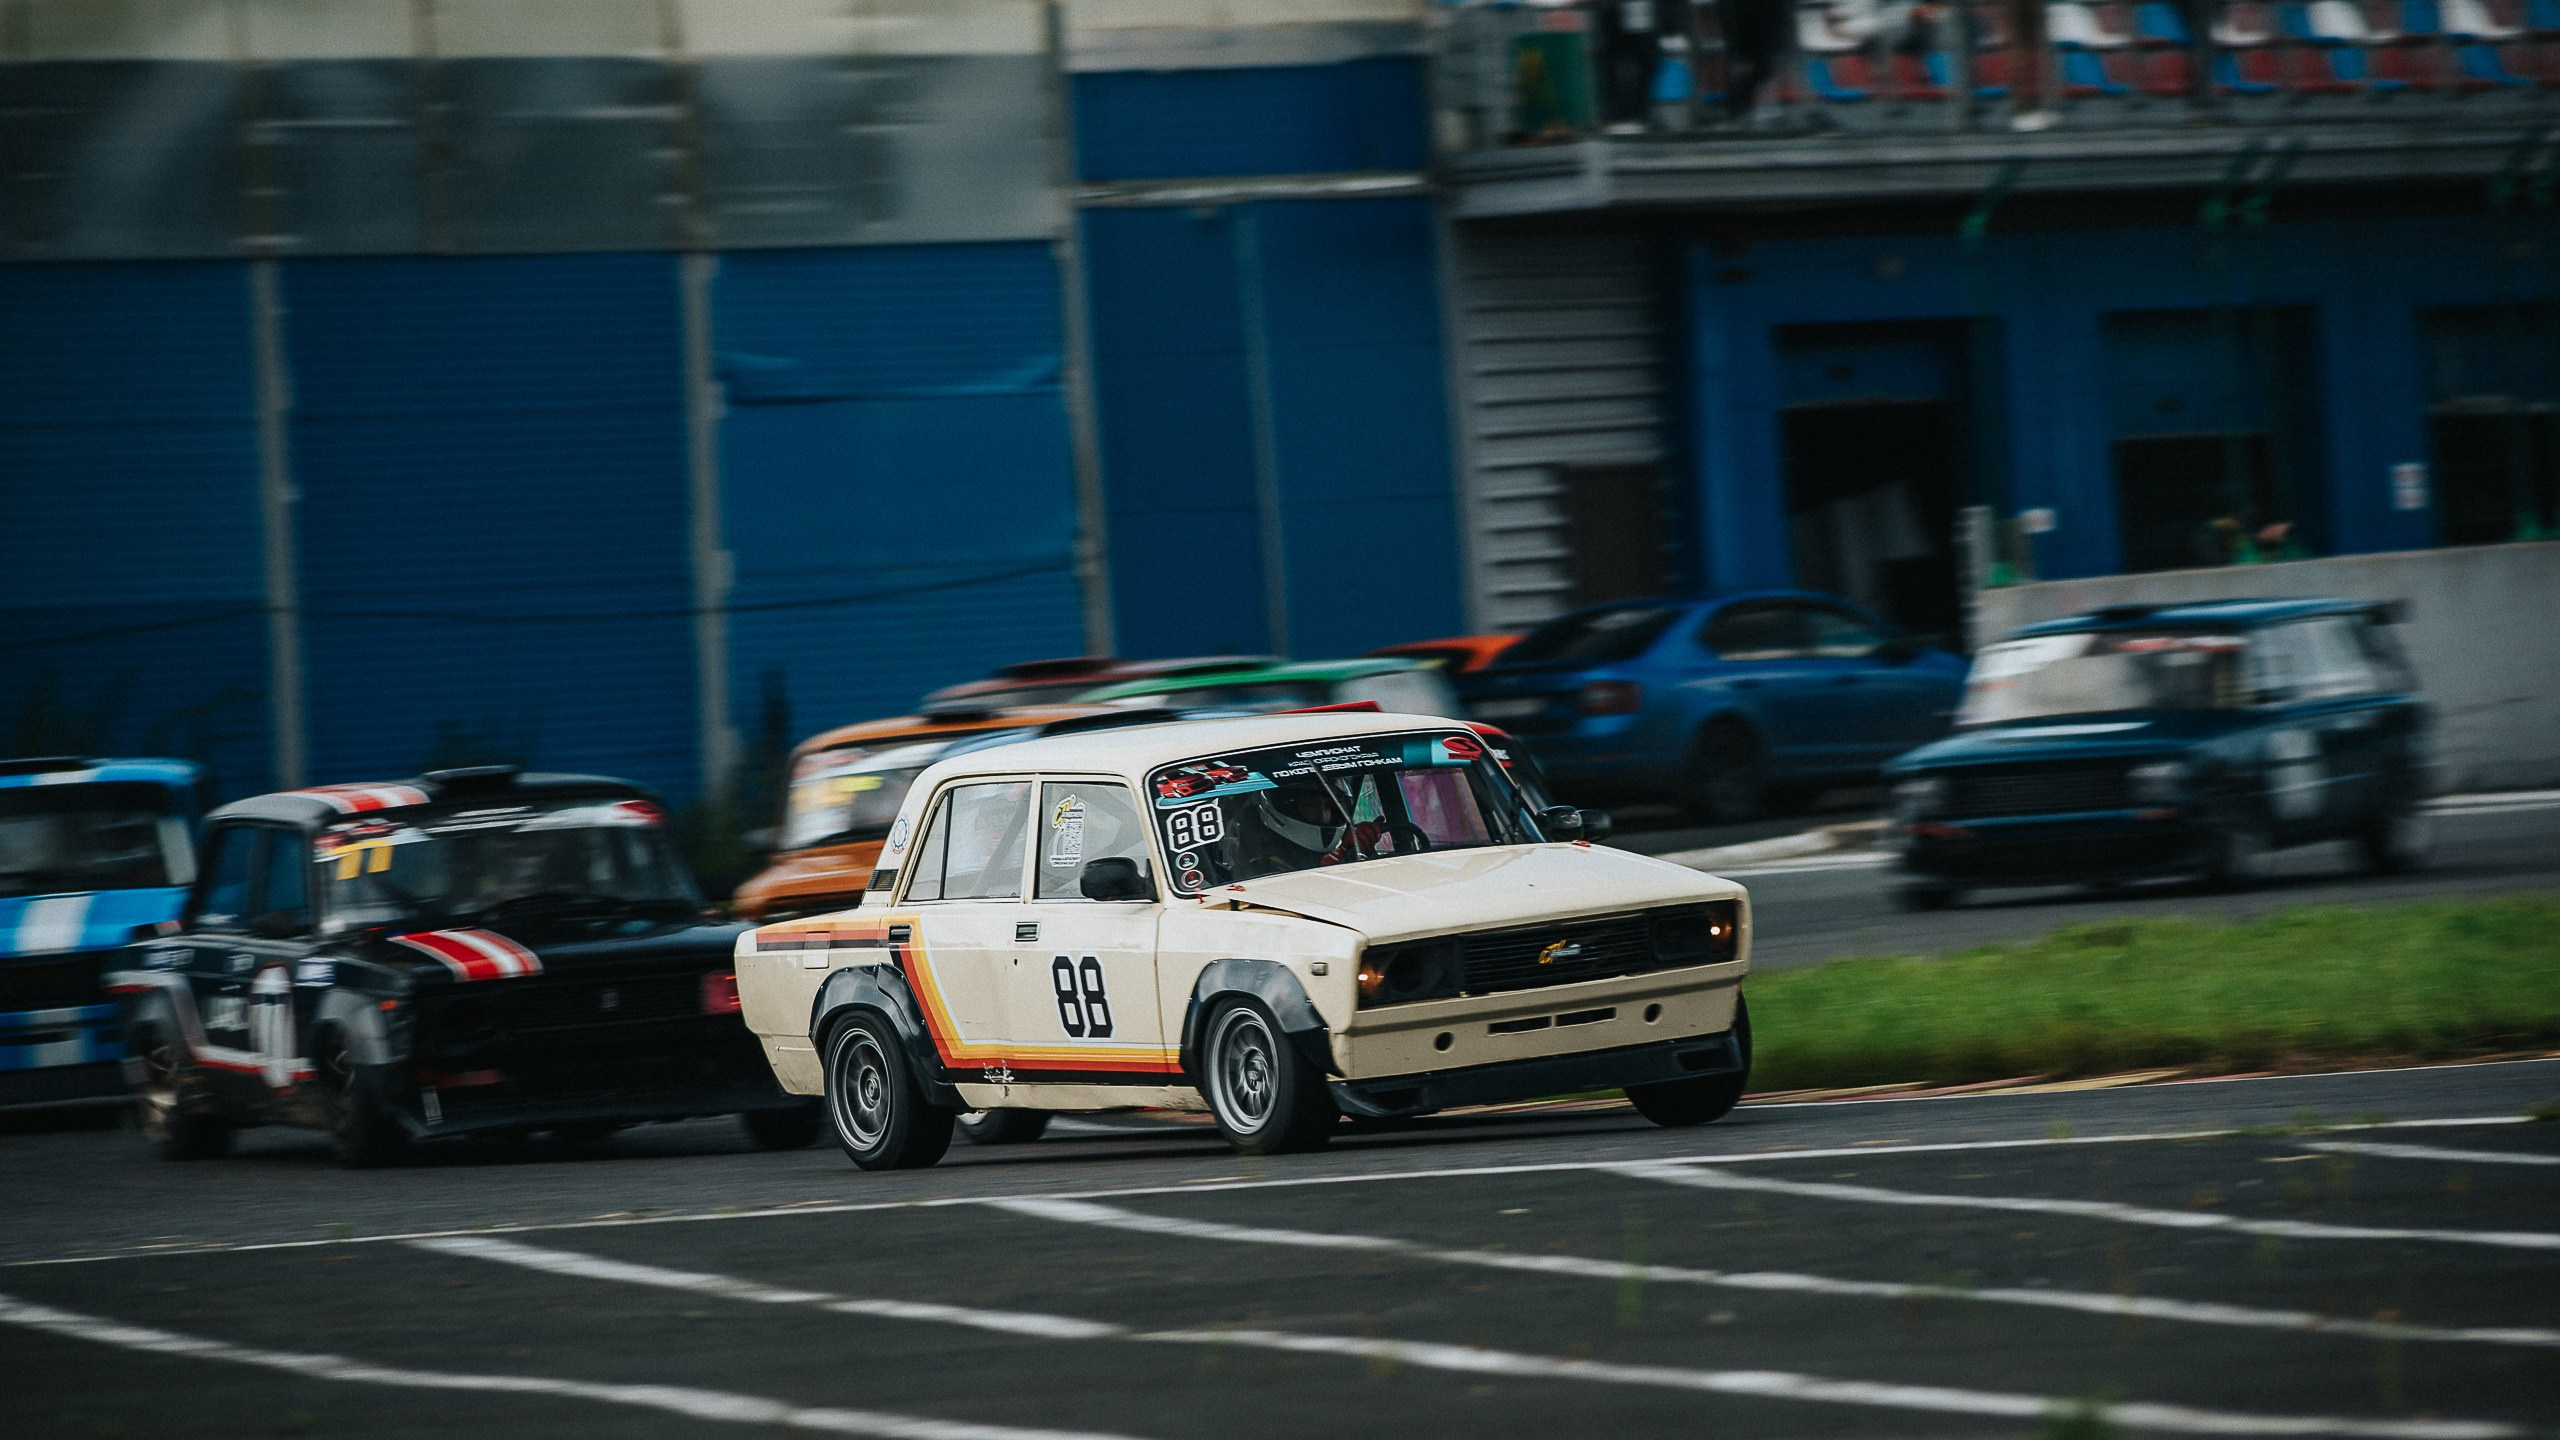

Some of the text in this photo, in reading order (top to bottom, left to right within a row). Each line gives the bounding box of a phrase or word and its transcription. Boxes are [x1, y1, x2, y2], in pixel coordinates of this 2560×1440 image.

[1288, 755, 1358, 767] КРАСОЯРСКОГО
[1295, 746, 1361, 757] ЧЕМПИОНАТ
[1272, 770, 1290, 778] ПО
[1357, 757, 1403, 767] ГОНКАМ
[1167, 804, 1225, 852] 88
[1051, 955, 1113, 1038] 88
